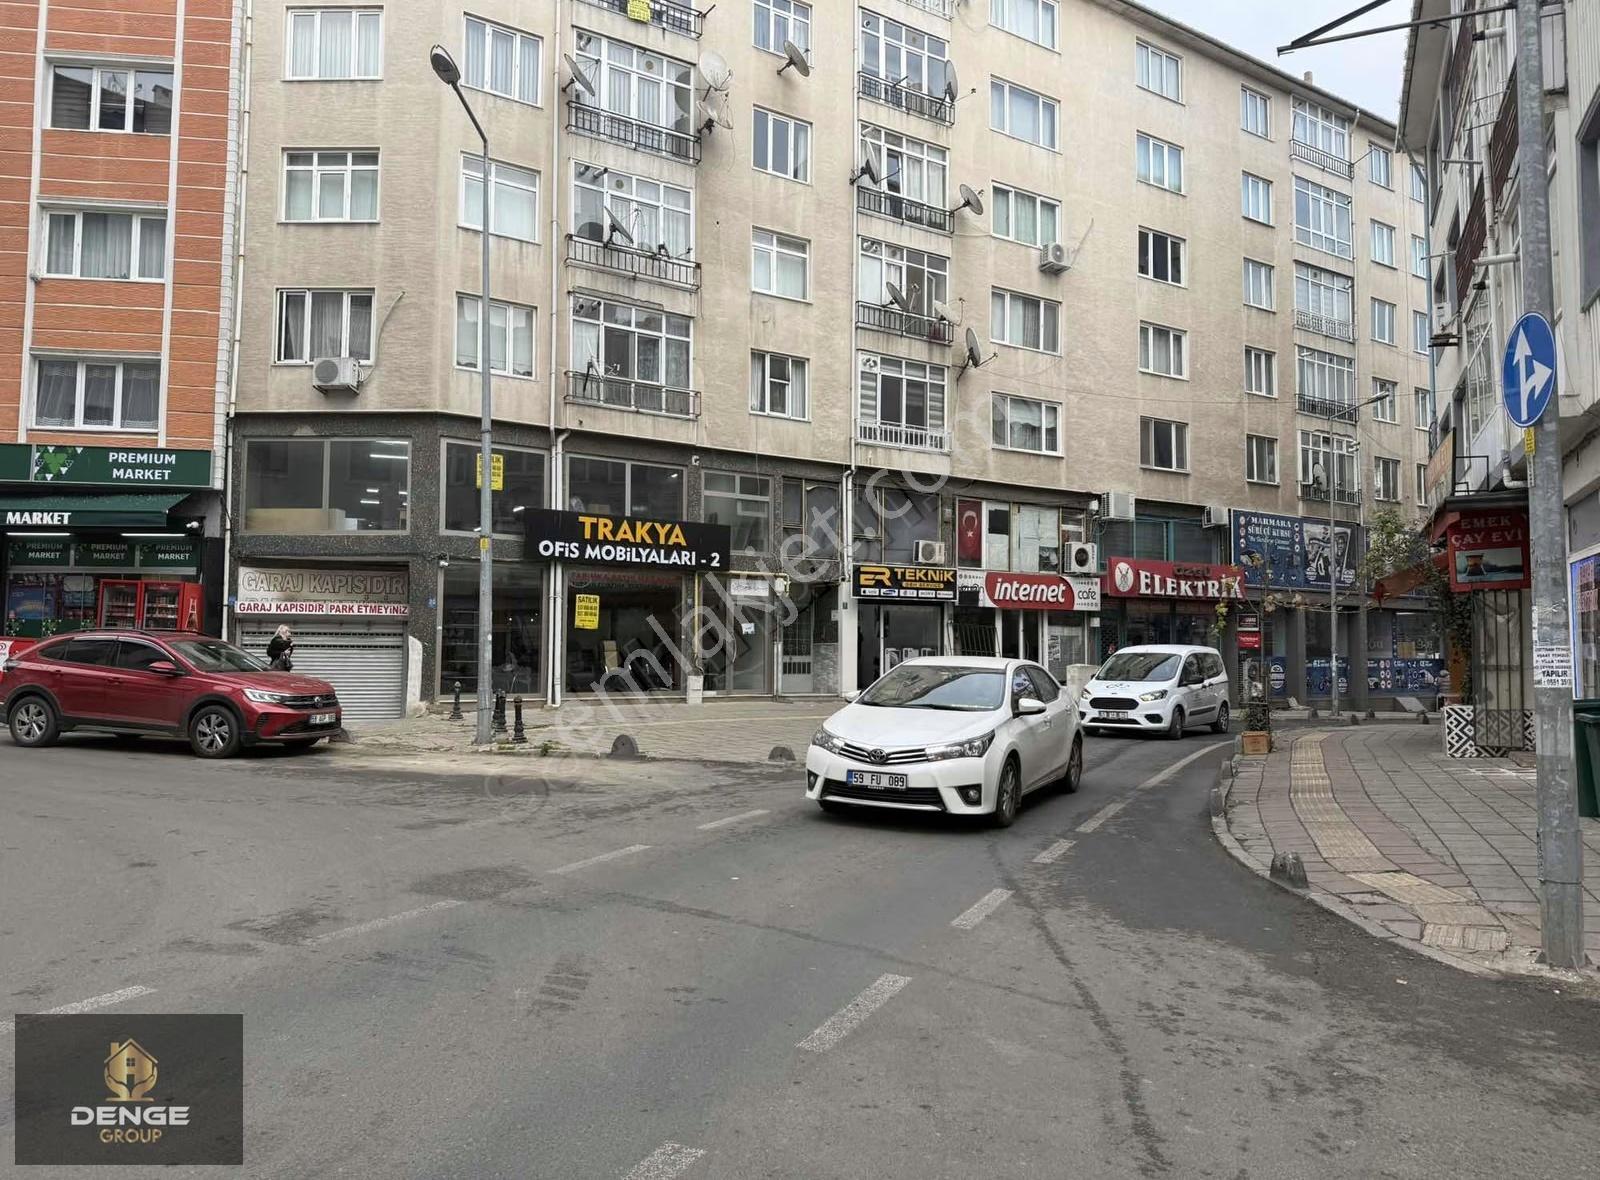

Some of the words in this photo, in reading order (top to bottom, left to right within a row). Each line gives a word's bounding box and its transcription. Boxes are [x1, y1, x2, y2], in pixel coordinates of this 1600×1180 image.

[109, 452, 176, 465] PREMIUM
[112, 468, 171, 480] MARKET
[6, 511, 71, 525] MARKET
[1461, 515, 1511, 529] EMEK
[578, 515, 687, 547] TRAKYA
[26, 542, 63, 551] PREMIUM
[91, 543, 128, 551] PREMIUM
[28, 552, 61, 560] MARKET
[93, 552, 125, 560] MARKET
[710, 552, 720, 567] 2
[242, 571, 304, 593] GARAJ
[993, 577, 1066, 603] internet
[1077, 588, 1096, 600] cafe
[239, 602, 272, 613] GARAJ
[329, 604, 355, 614] PARK
[853, 773, 864, 784] 59
[870, 775, 882, 785] FU
[888, 775, 905, 788] 089
